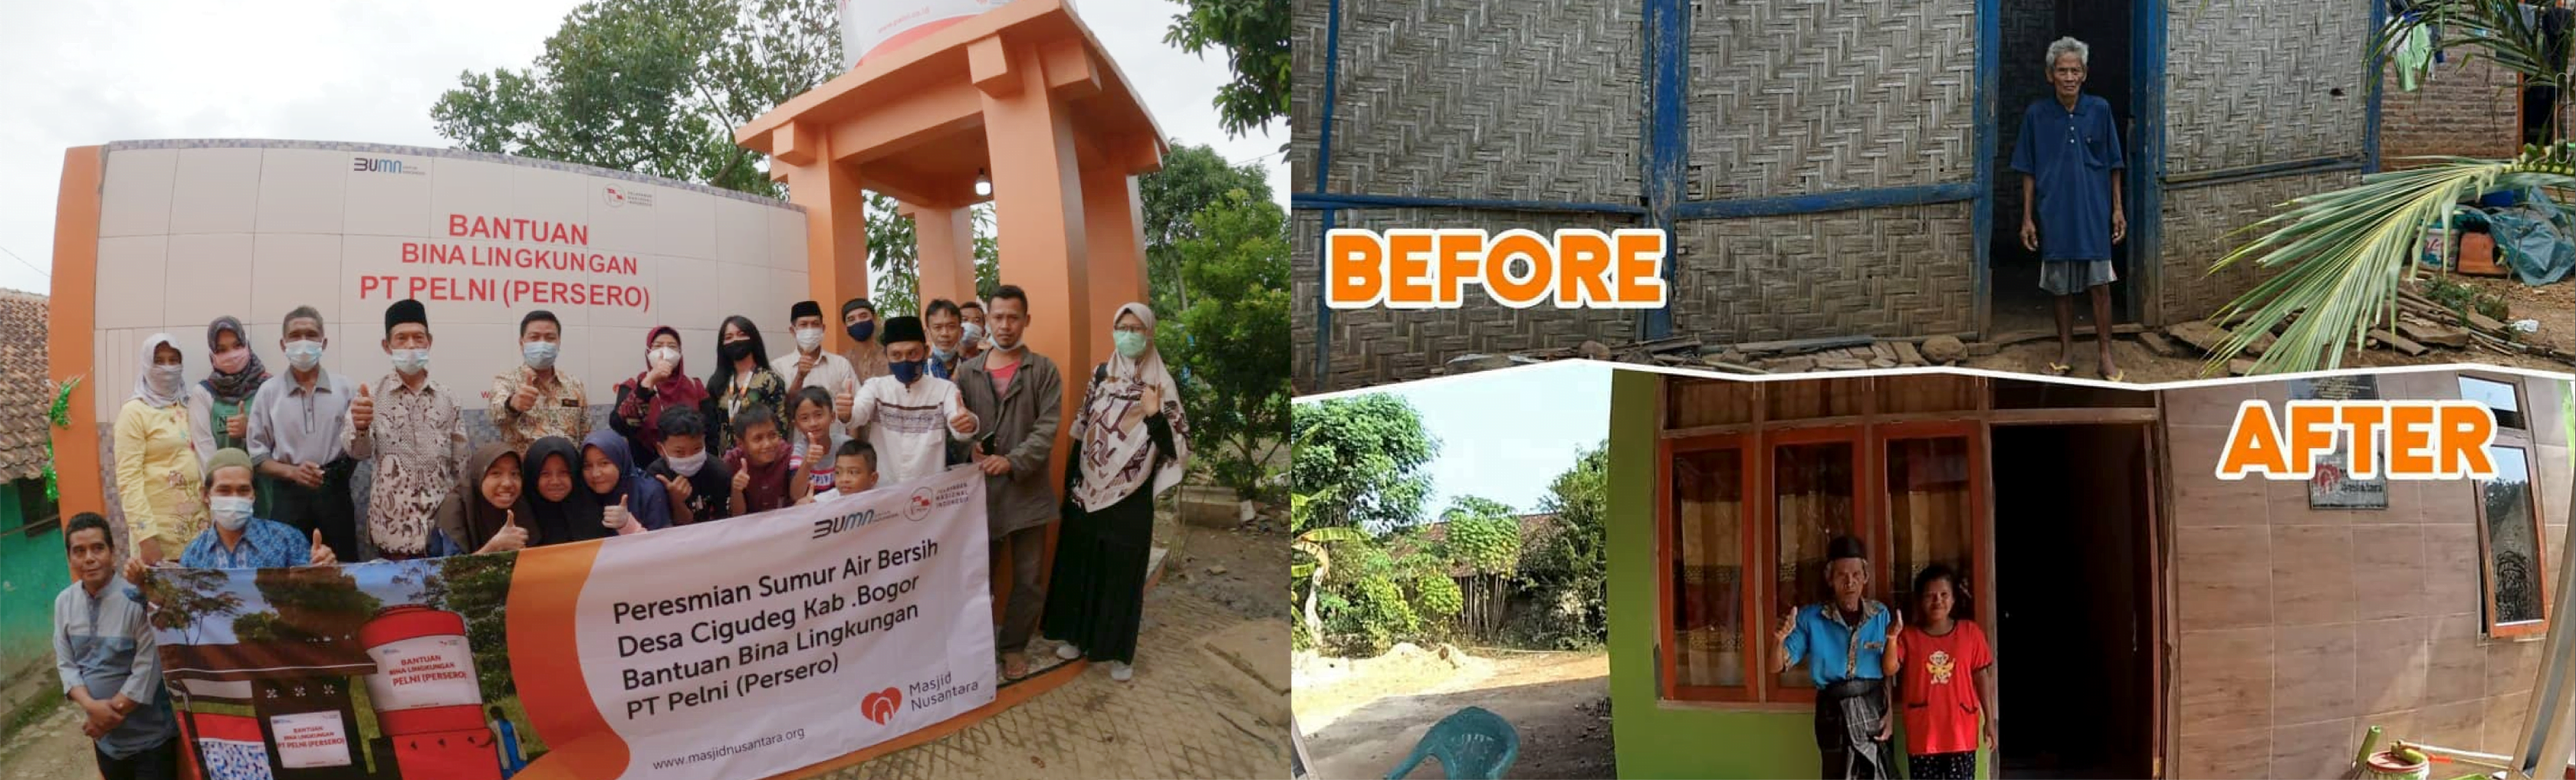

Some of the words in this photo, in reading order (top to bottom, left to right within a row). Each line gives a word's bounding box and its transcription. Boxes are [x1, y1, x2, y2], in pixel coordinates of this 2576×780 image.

[449, 214, 588, 245] BANTUAN
[401, 242, 466, 266] BINA
[472, 245, 638, 276] LINGKUNGAN
[360, 275, 399, 300] PT
[409, 276, 495, 302] PELNI
[502, 279, 650, 313] (PERSERO)
[613, 585, 751, 624] Peresmian
[758, 565, 836, 597] Sumur
[843, 556, 872, 580] Air
[877, 538, 938, 570] Bersih
[618, 632, 684, 658] Desa
[691, 608, 796, 644] Cigudeg
[803, 593, 845, 621] Kab
[851, 575, 919, 608] .Bogor
[401, 655, 442, 666] BANTUAN
[622, 655, 731, 690] Bantuan
[738, 641, 789, 666] Bina
[797, 604, 918, 651] Lingkungan
[393, 675, 421, 687] PELNI
[626, 696, 660, 720] PT
[668, 680, 729, 711] Pelni
[736, 651, 840, 697] (Persero)
[909, 672, 952, 697] Masjid
[911, 680, 979, 712] Nusantara
[652, 728, 806, 770] www.masjidnusantara.org
